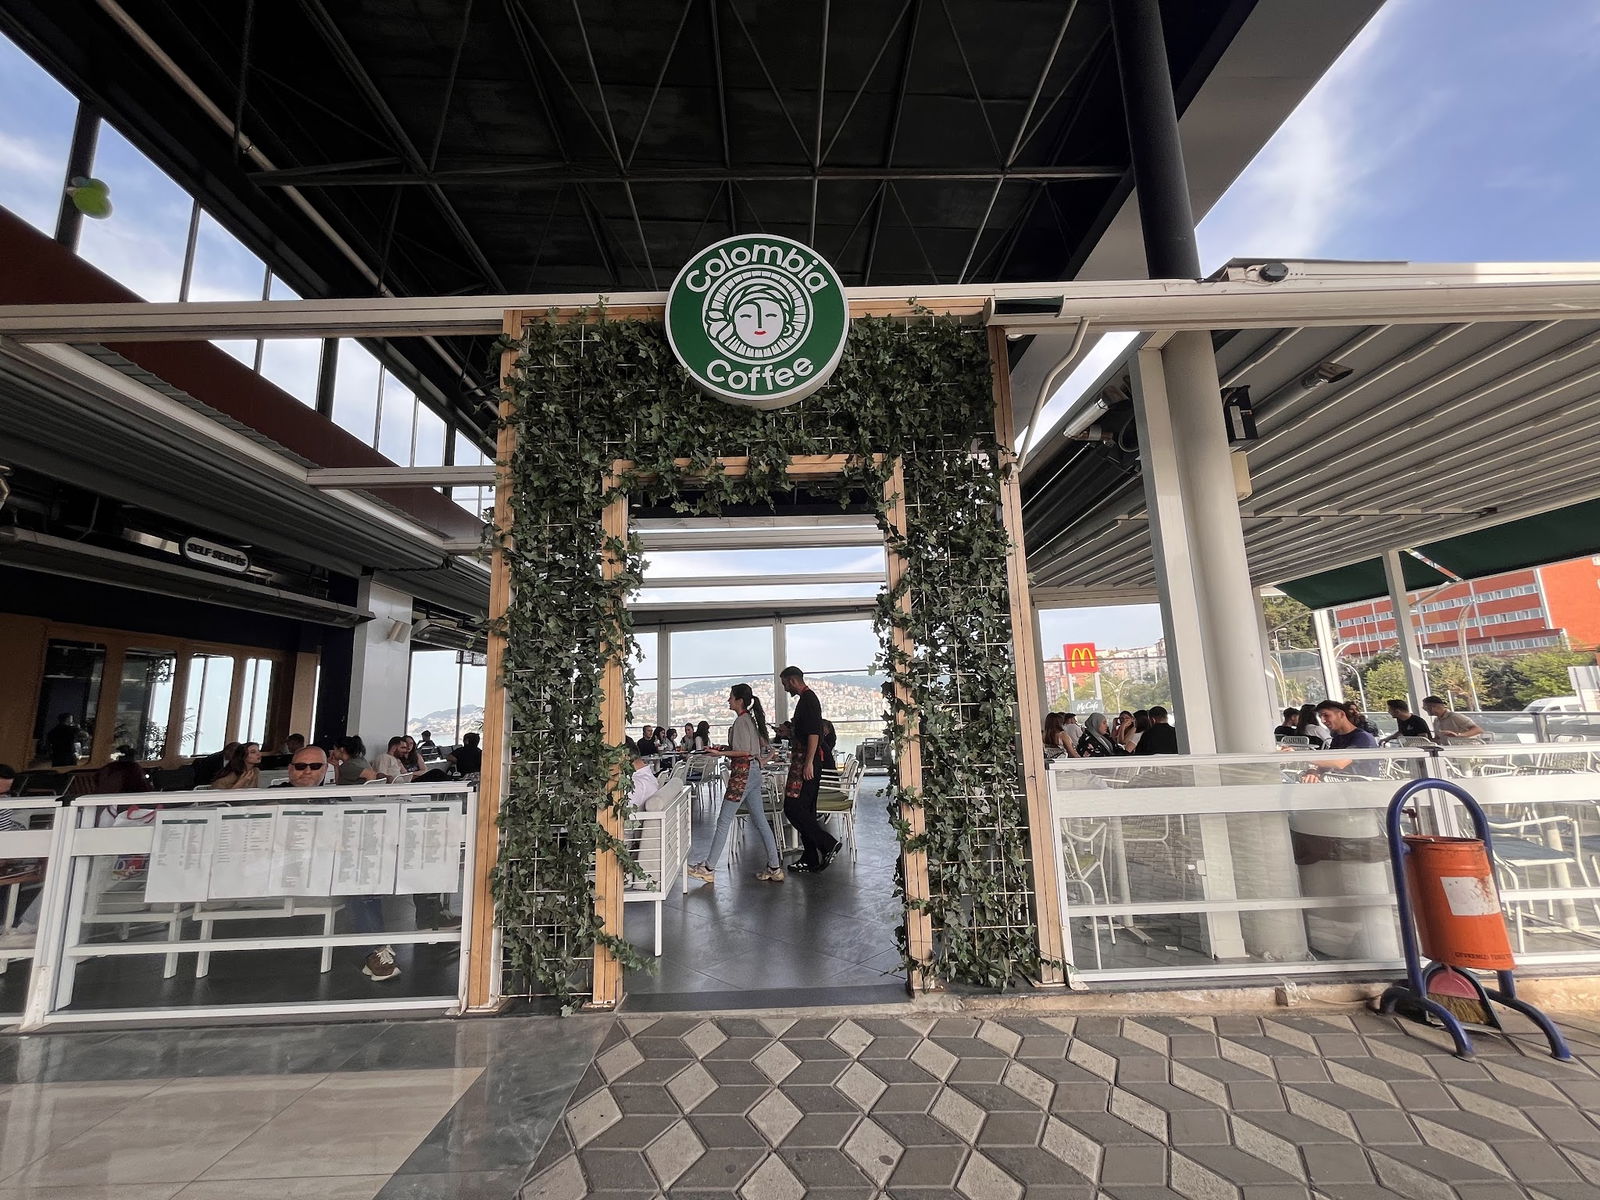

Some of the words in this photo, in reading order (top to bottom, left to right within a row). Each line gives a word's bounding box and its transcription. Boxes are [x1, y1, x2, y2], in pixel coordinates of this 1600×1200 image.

[685, 244, 829, 294] Colombia
[706, 357, 814, 392] Coffee
[187, 543, 212, 556] SELF
